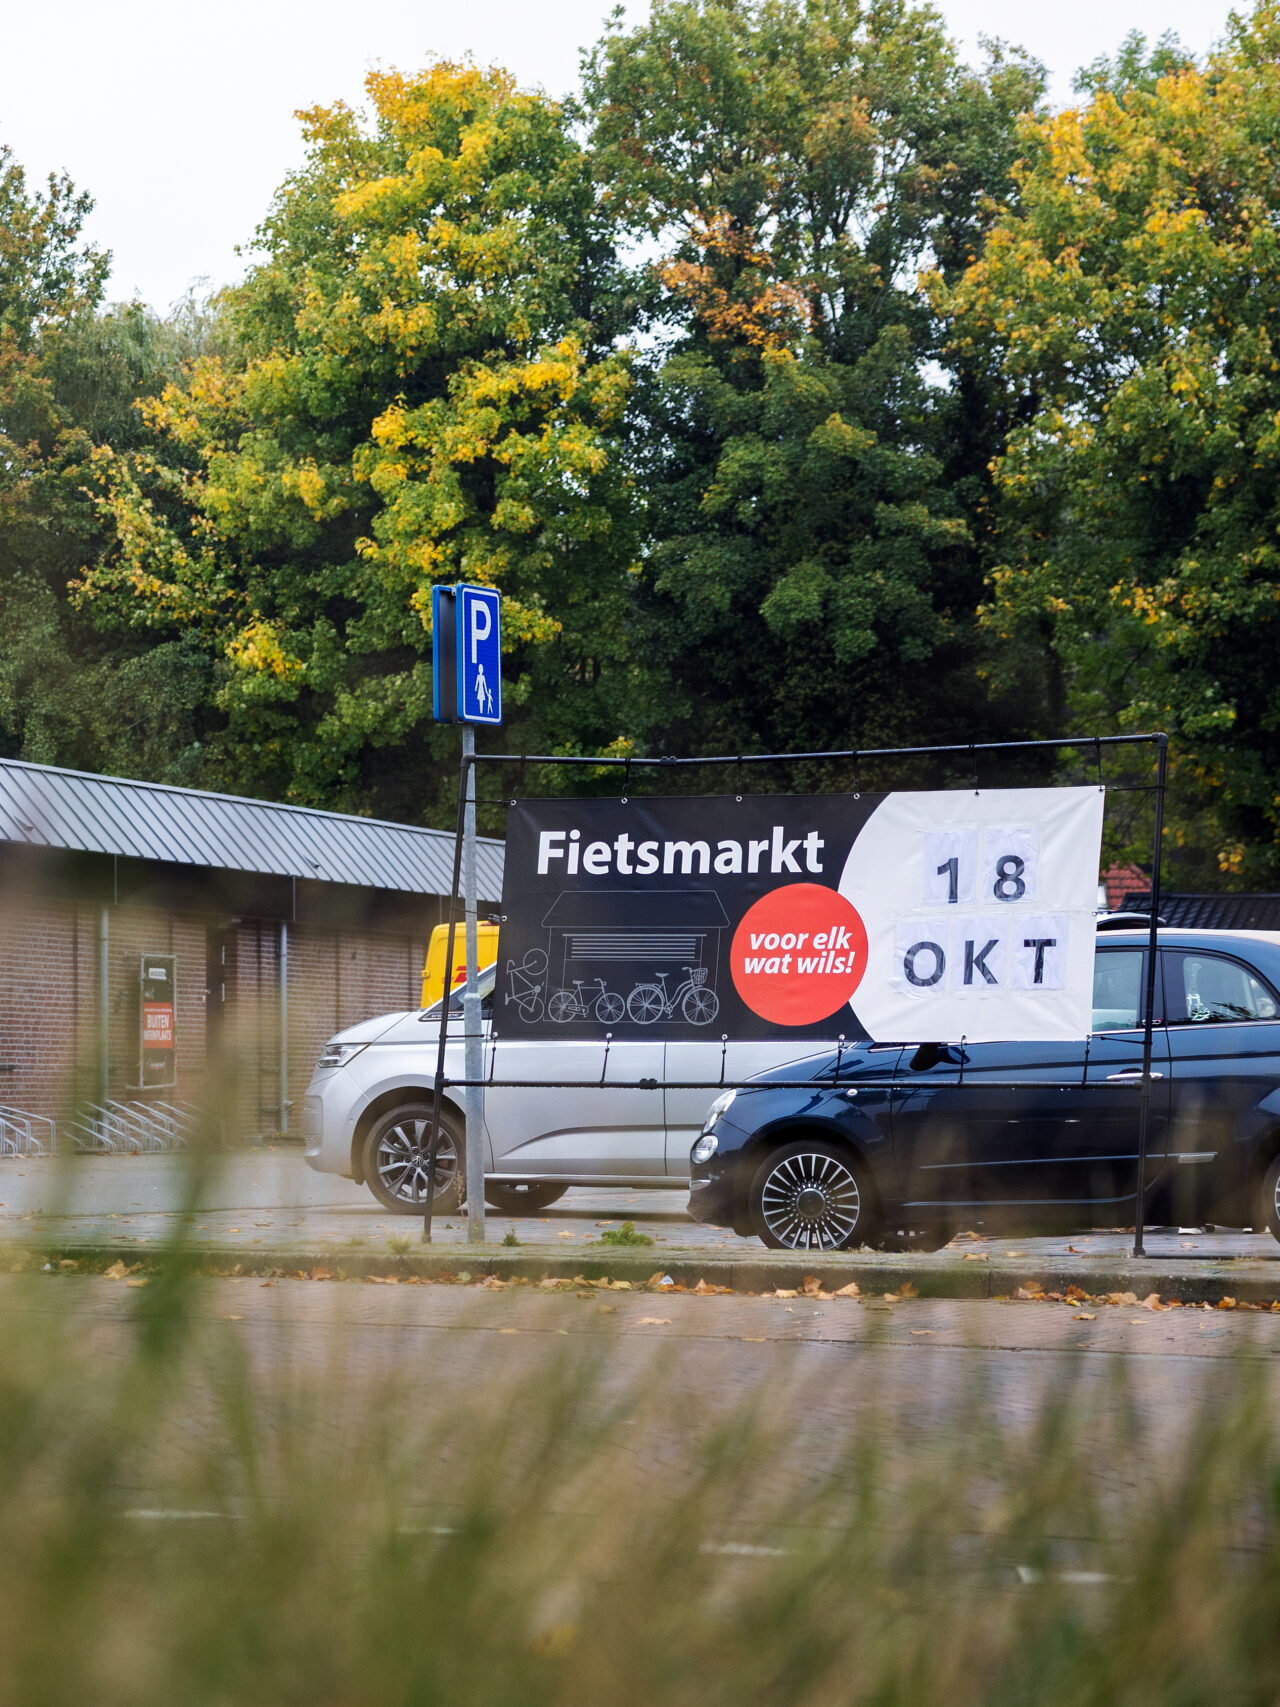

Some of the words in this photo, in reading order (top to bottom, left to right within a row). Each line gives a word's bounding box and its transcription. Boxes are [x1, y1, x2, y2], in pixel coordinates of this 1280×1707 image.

[469, 599, 492, 664] P
[536, 825, 826, 875] Fietsmarkt
[936, 855, 1026, 904] 18
[744, 954, 791, 975] wat
[795, 949, 855, 975] wils!
[749, 930, 809, 951] voor
[812, 925, 852, 951] elk
[903, 938, 1056, 987] OKT
[147, 1014, 169, 1028] BUITEN
